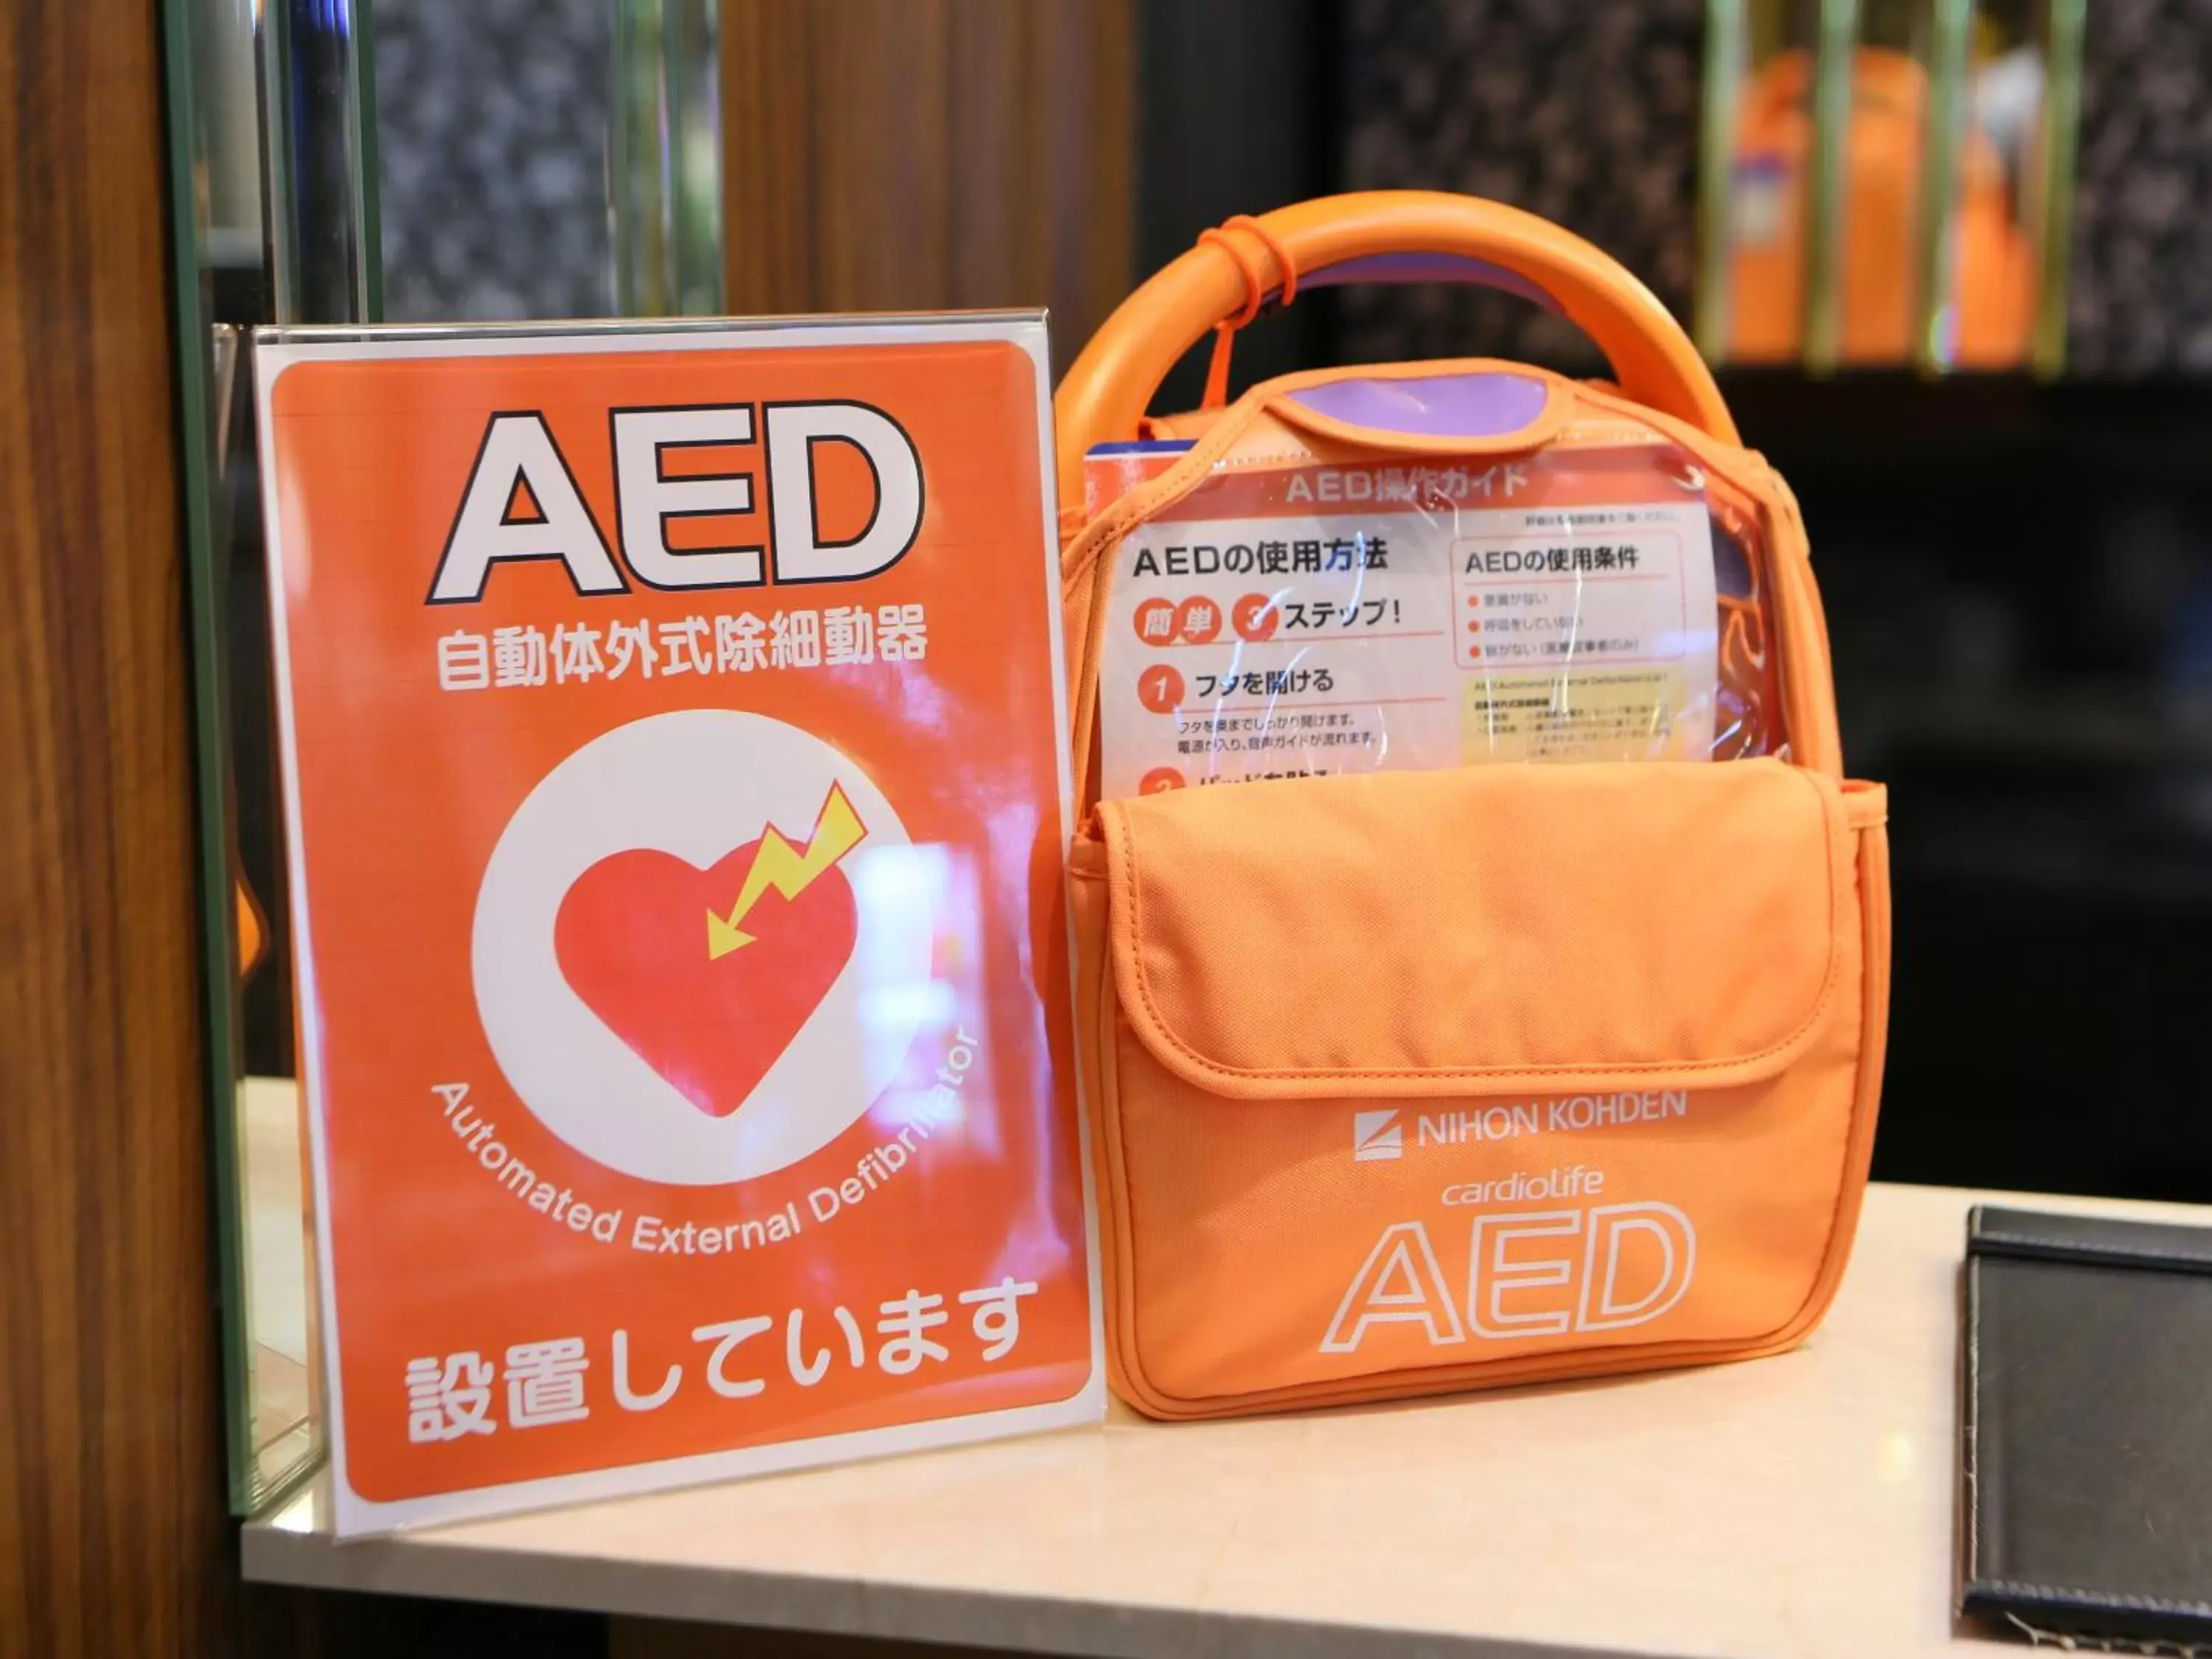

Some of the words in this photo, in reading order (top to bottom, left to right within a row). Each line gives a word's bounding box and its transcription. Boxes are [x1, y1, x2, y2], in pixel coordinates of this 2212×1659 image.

[423, 398, 925, 605] AED
[1286, 463, 1529, 502] AED操作ガイド
[1133, 538, 1388, 577] AEDの使用方法
[1465, 546, 1640, 574] AEDの使用条件
[436, 603, 928, 691] 自動体外式除細動器
[1195, 669, 1334, 697] フタを開ける
[431, 1079, 622, 1244] Automated
[632, 1201, 801, 1255] External
[807, 1025, 978, 1223] Defibrillator
[1418, 1103, 1538, 1147] NIHON
[1549, 1088, 1687, 1131] KOHDEN
[1318, 1201, 1696, 1352] AED
[404, 1276, 1038, 1444] 設置しています
